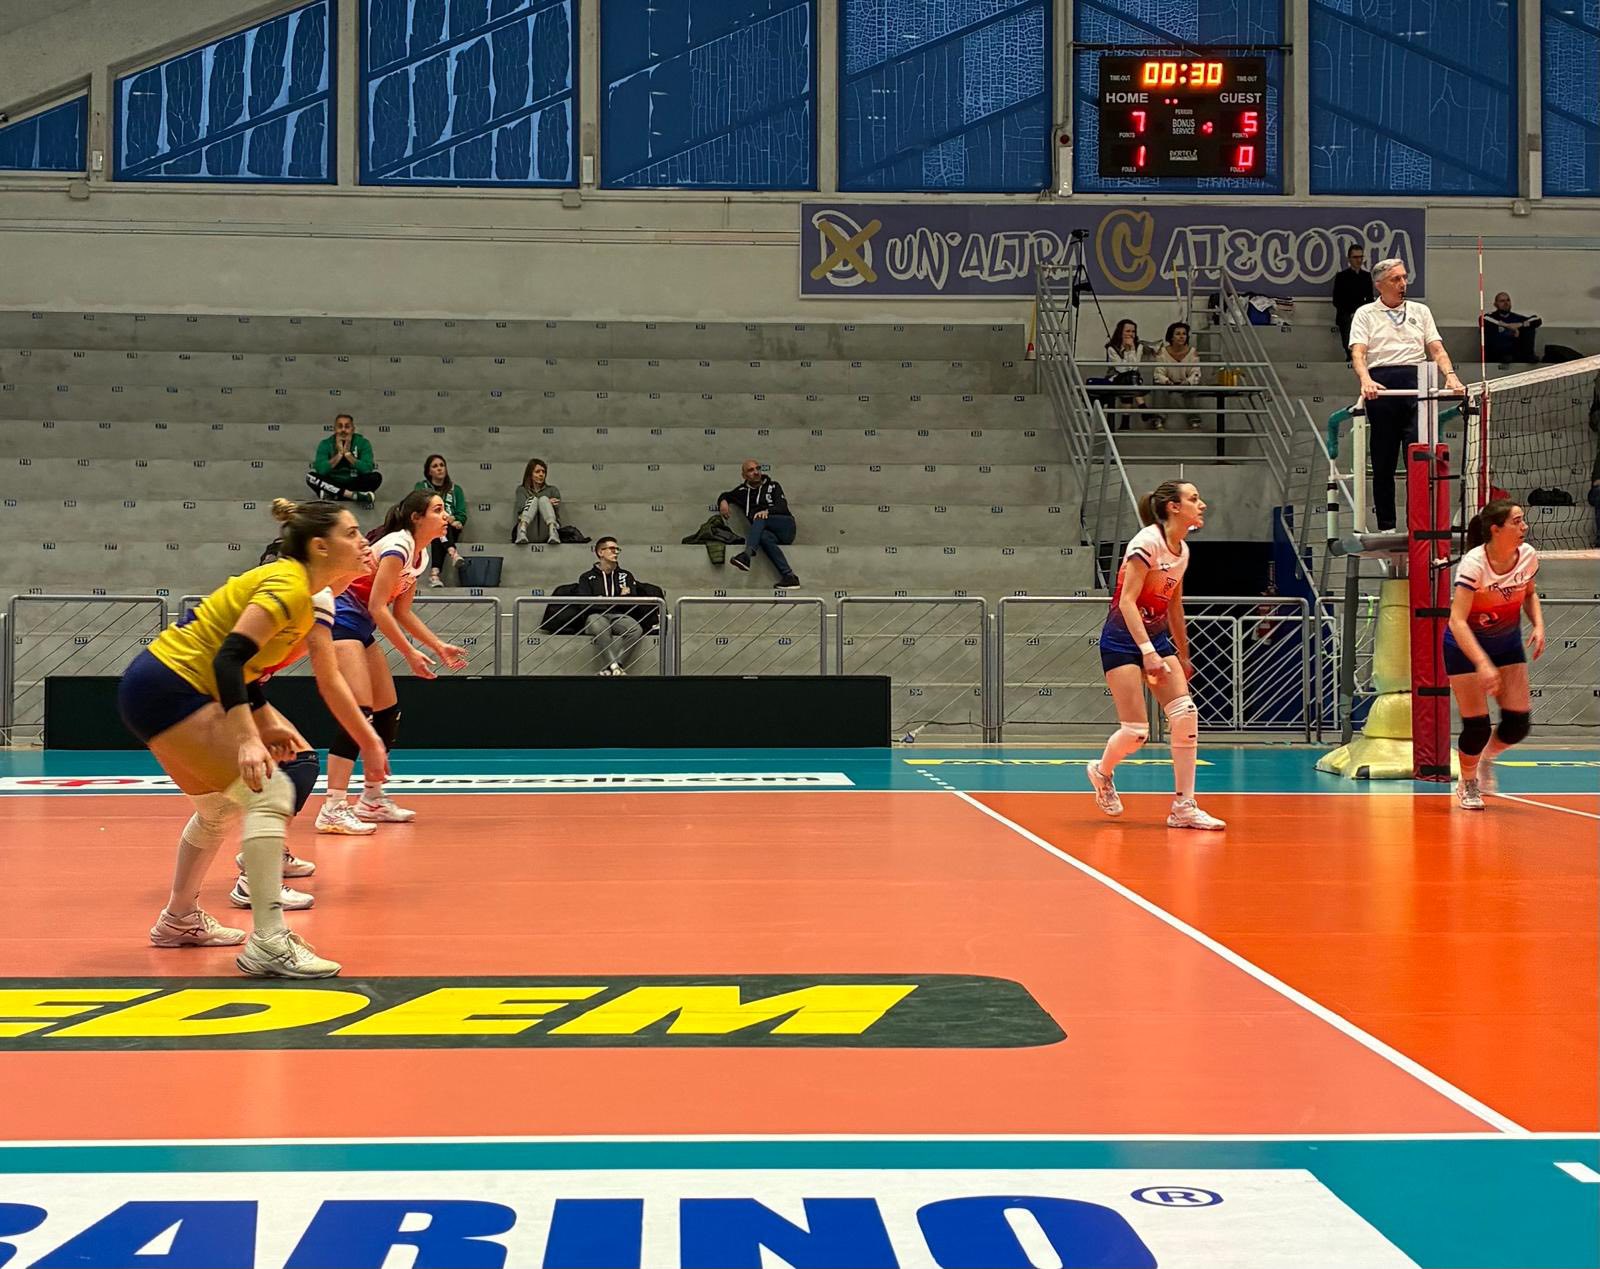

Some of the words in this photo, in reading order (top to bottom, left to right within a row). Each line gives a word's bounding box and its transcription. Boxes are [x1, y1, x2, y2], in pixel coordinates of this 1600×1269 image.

[1143, 62, 1223, 84] 00:30
[1105, 92, 1149, 103] HOME
[1219, 92, 1262, 103] GUEST
[1132, 111, 1146, 132] 7
[1172, 118, 1196, 128] BONUS
[1172, 127, 1195, 135] SERVICE
[1243, 111, 1258, 132] 5
[1138, 145, 1146, 166] 1
[1238, 146, 1254, 166] 0
